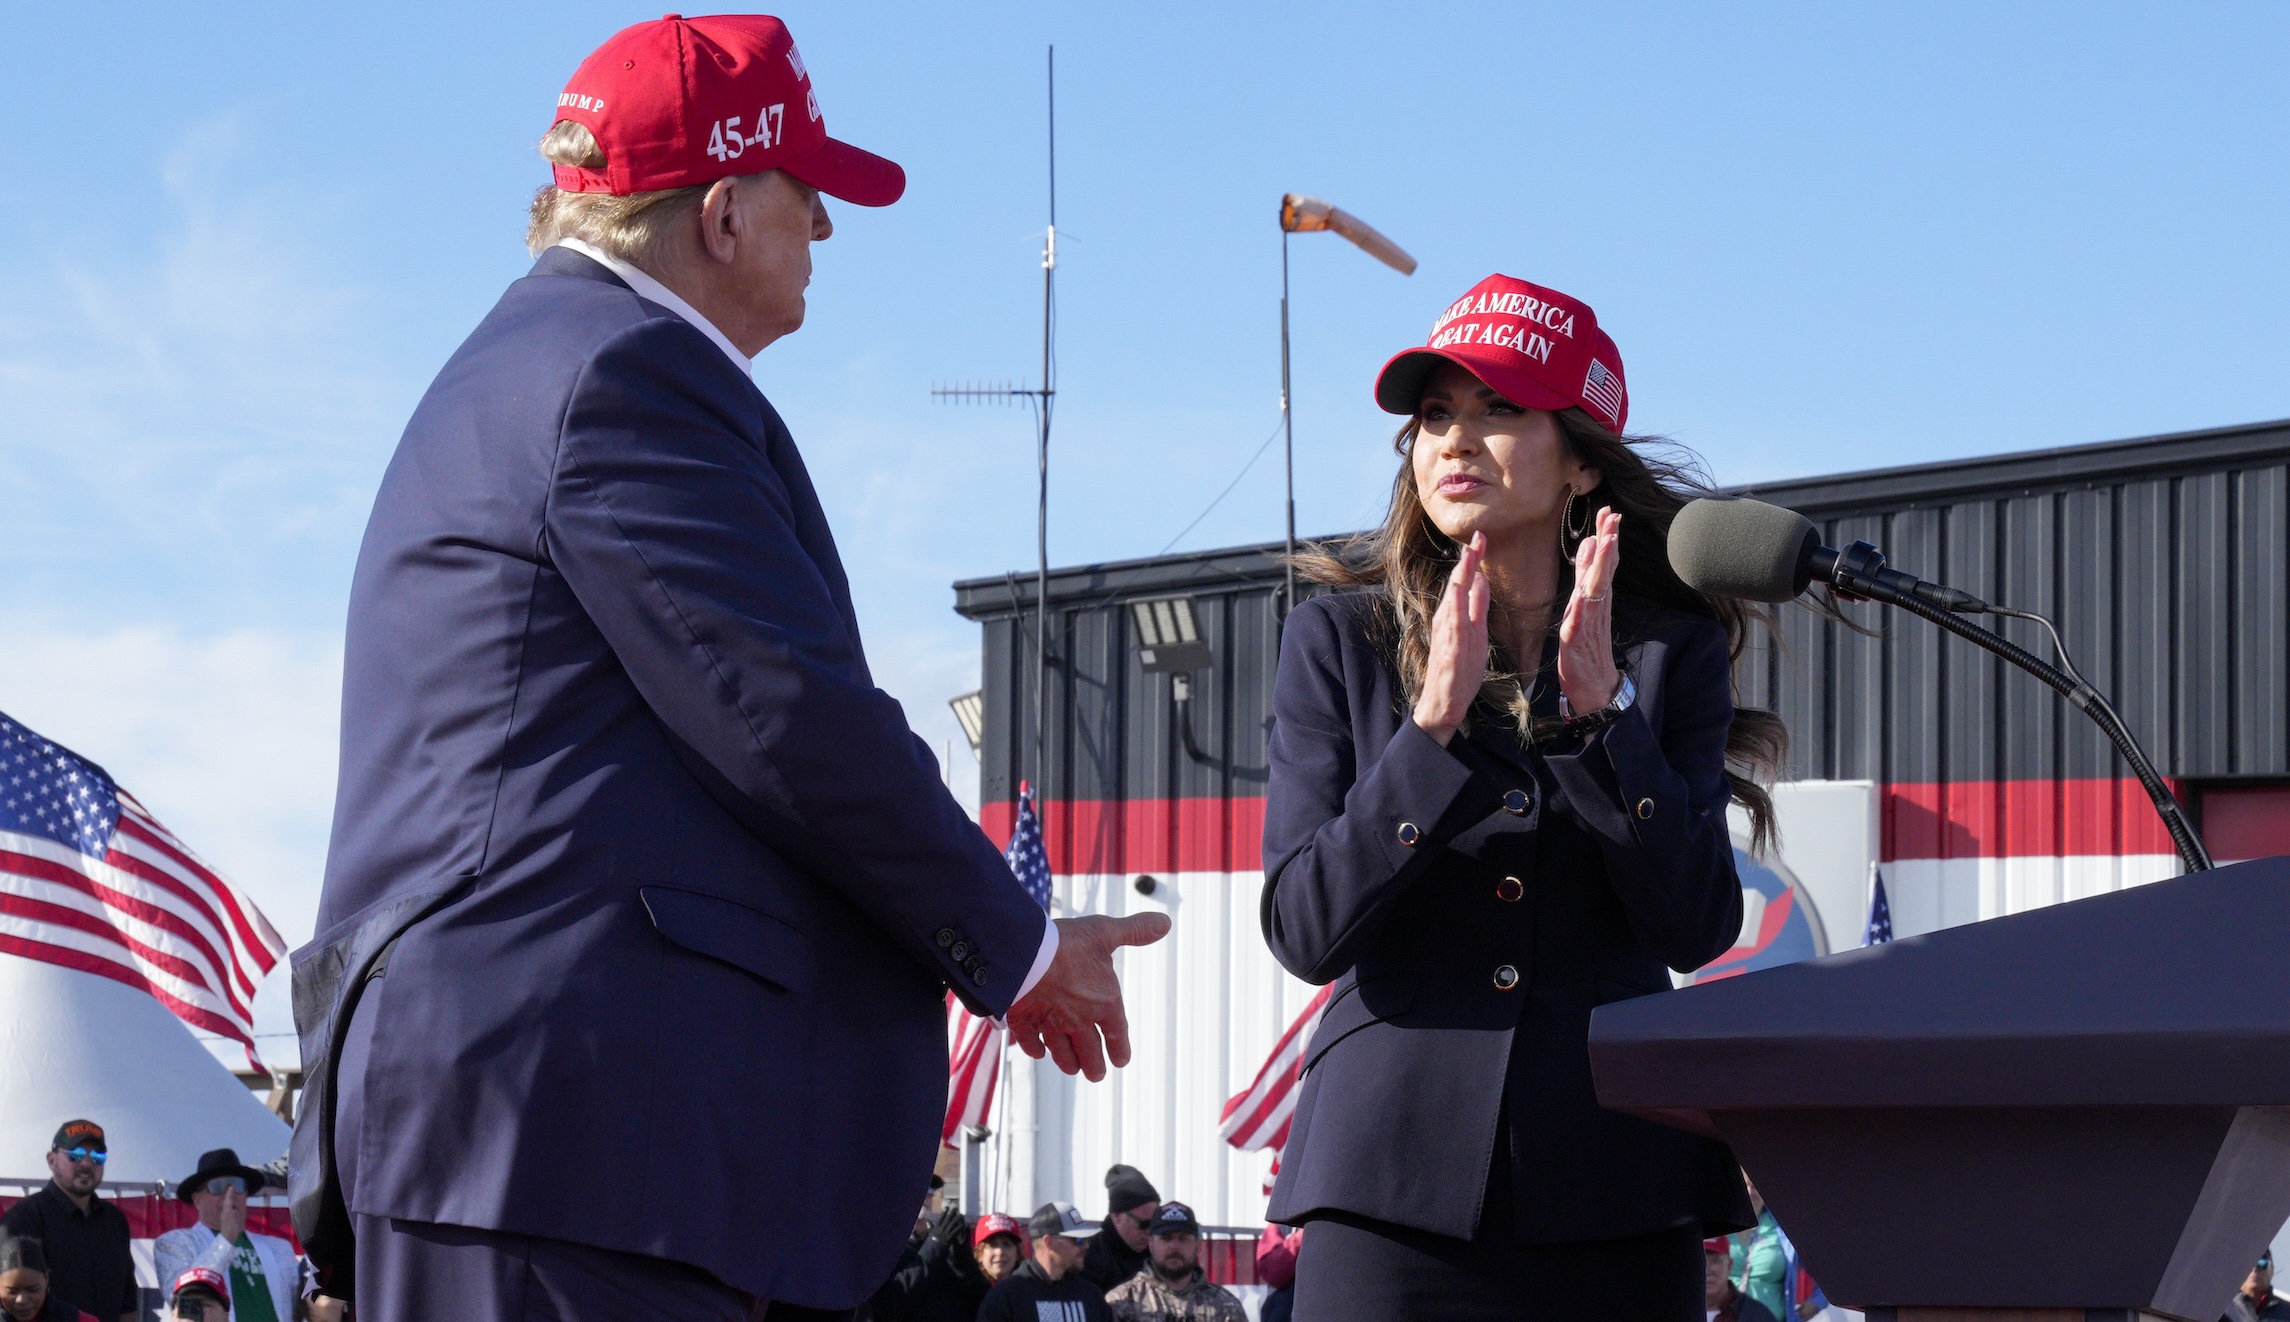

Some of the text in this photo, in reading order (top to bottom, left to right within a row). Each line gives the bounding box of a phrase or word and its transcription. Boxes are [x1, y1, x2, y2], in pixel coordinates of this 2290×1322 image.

[706, 102, 785, 163] 45-47
[1428, 291, 1575, 342] MAKE AMERICA
[1429, 322, 1556, 365] REAT AGAIN
